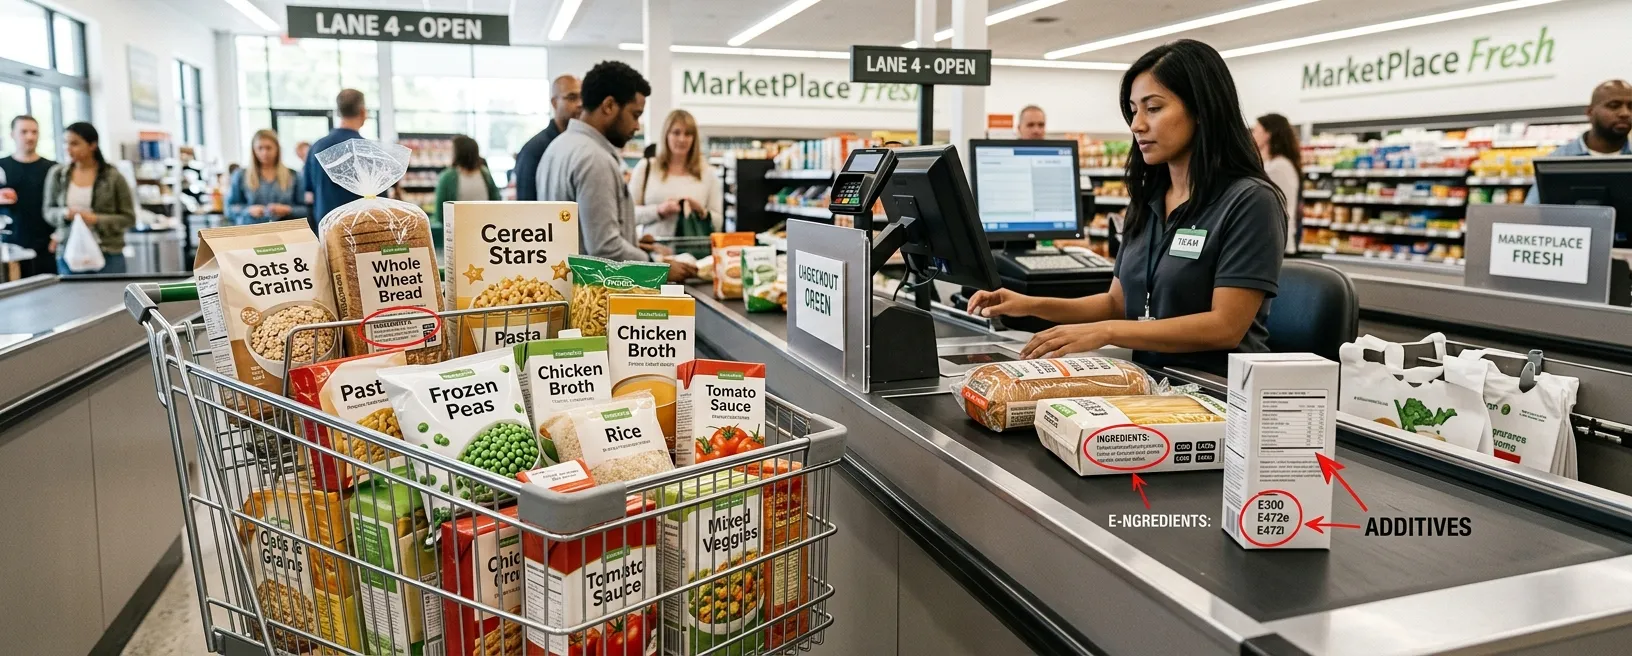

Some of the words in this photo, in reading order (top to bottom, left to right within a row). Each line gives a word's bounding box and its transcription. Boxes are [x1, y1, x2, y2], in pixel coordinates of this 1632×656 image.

[316, 12, 380, 36] LANE
[384, 15, 400, 37] 4
[418, 16, 483, 40] OPEN
[866, 55, 908, 73] LANE
[911, 57, 921, 74] 4
[933, 57, 976, 75] OPEN
[1301, 48, 1459, 90] MarketPlace
[1467, 25, 1556, 73] Fresh
[683, 70, 850, 99] MarketPlace
[481, 223, 553, 243] Cereal
[1498, 234, 1583, 249] MARKETPLACE
[371, 257, 421, 273] Whole
[489, 245, 547, 265] Stars
[1512, 249, 1563, 266] FRESH
[242, 260, 290, 279] Oats
[293, 257, 310, 273] &
[249, 276, 313, 297] Grains
[373, 272, 423, 288] Wheat
[379, 286, 422, 303] Bread
[495, 330, 541, 346] Pasta
[617, 325, 687, 341] Chicken
[628, 342, 676, 358] Broth
[538, 363, 603, 380] Chicken
[340, 379, 386, 402] Past
[428, 378, 499, 404] Frozen
[549, 379, 595, 396] Broth
[705, 384, 756, 399] Tomato
[446, 399, 495, 420] Peas
[710, 399, 751, 413] Sauce
[605, 424, 642, 444] Rice
[1096, 433, 1150, 443] INGREDIENTS:
[1258, 499, 1284, 510] E300
[708, 508, 750, 535] Mixed
[1257, 512, 1290, 522] E472e
[260, 530, 288, 552] Oats
[702, 527, 758, 553] Veggies
[263, 549, 303, 572] Grans
[487, 551, 521, 572] Chic
[593, 580, 641, 606] Sauce
